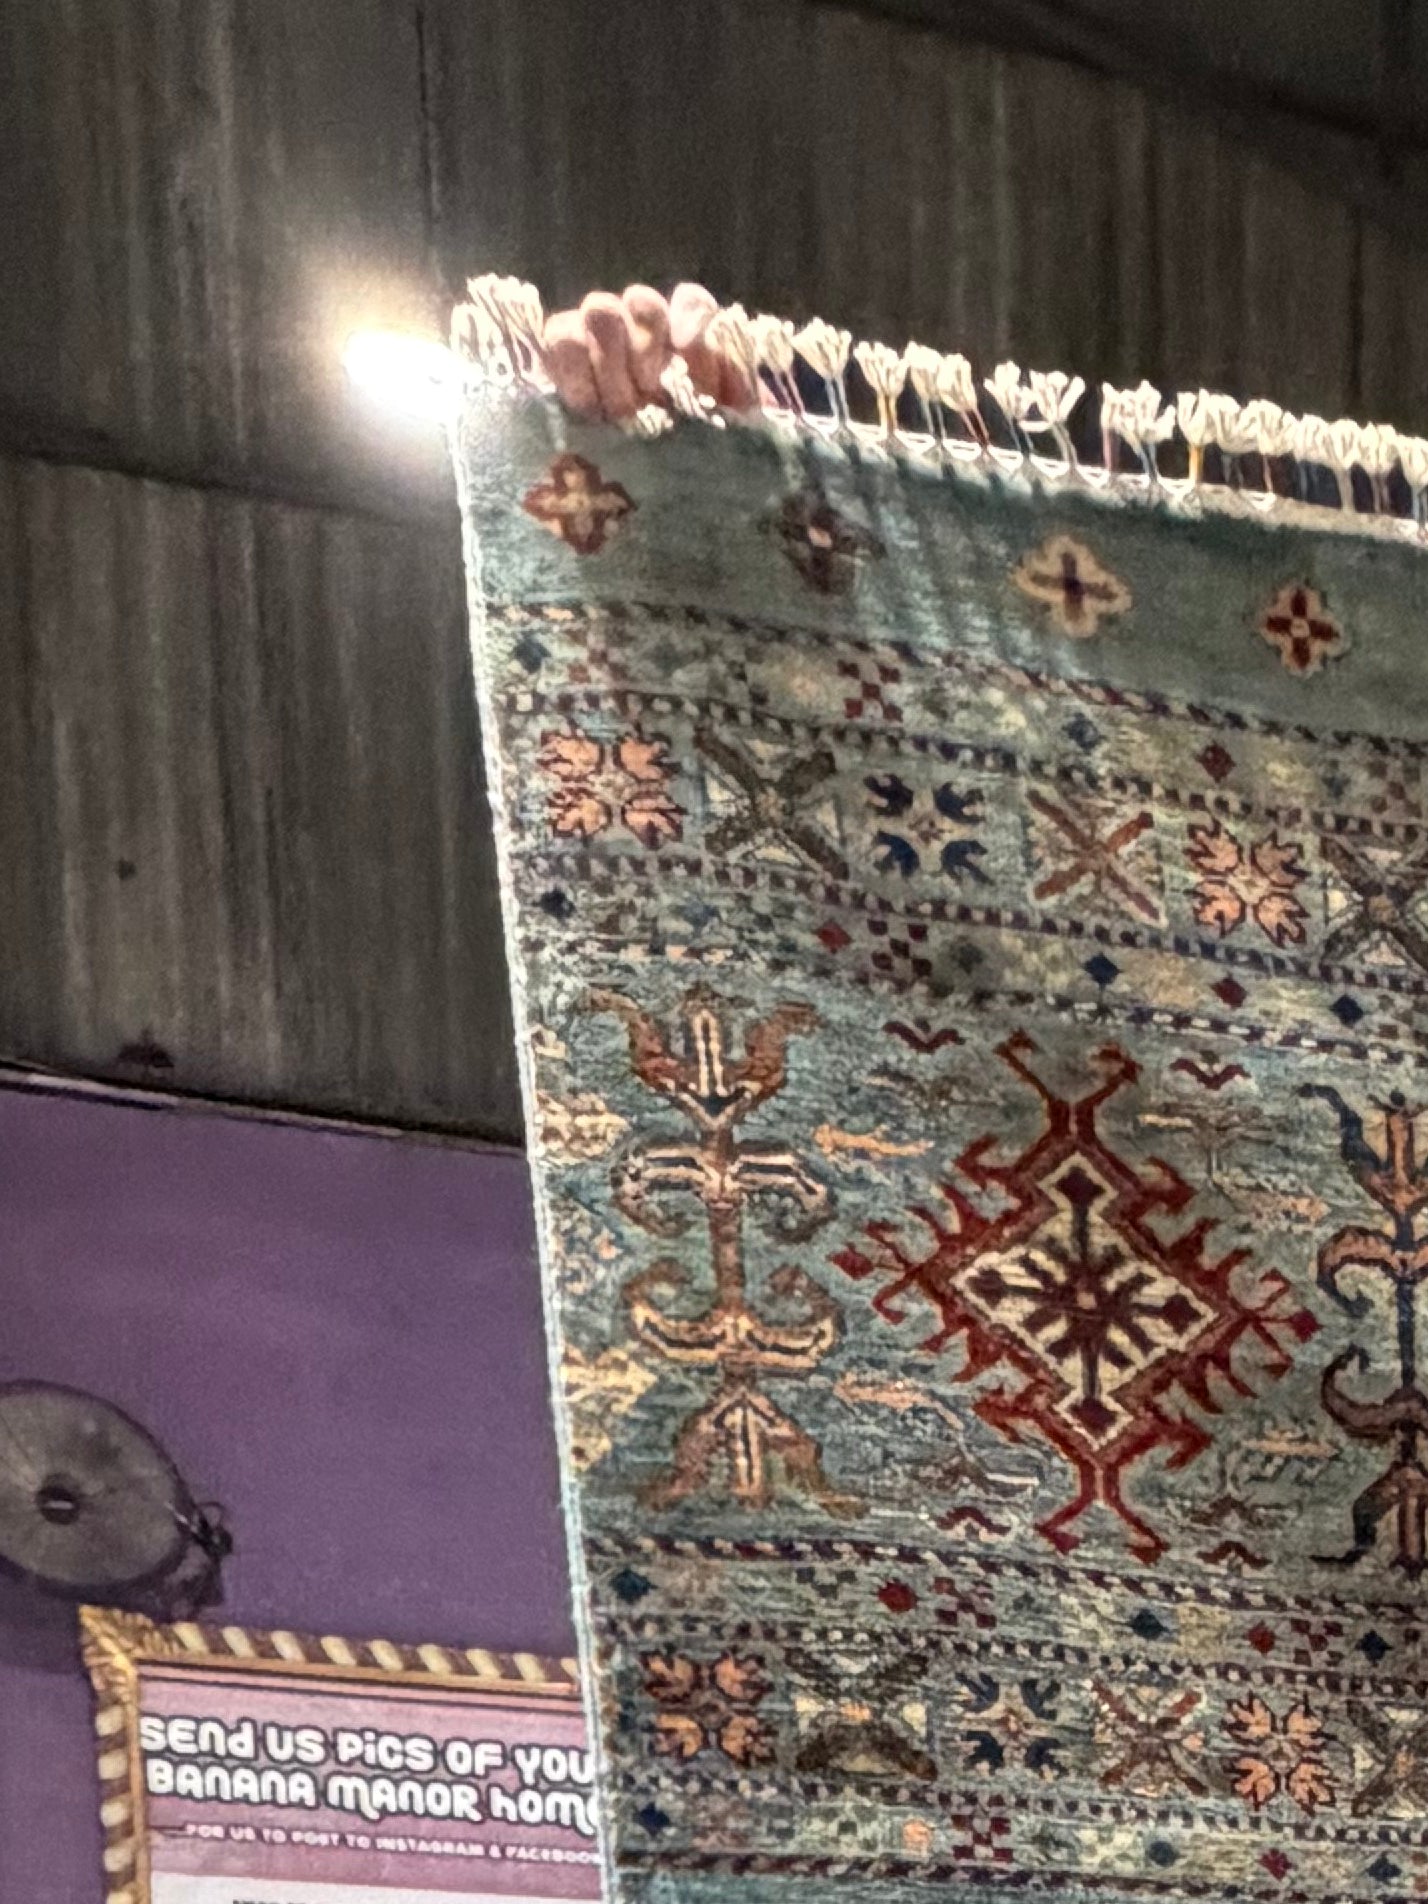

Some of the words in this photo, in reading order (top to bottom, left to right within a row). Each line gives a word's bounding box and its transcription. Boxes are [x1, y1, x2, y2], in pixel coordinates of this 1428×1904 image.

[265, 1725, 327, 1765] US
[445, 1740, 505, 1777] OF
[185, 1823, 226, 1839] FOR
[228, 1825, 257, 1841] US
[262, 1827, 288, 1844] TO
[290, 1830, 340, 1847] POST
[346, 1833, 371, 1849] TO
[375, 1835, 486, 1857] INSTAGRAM
